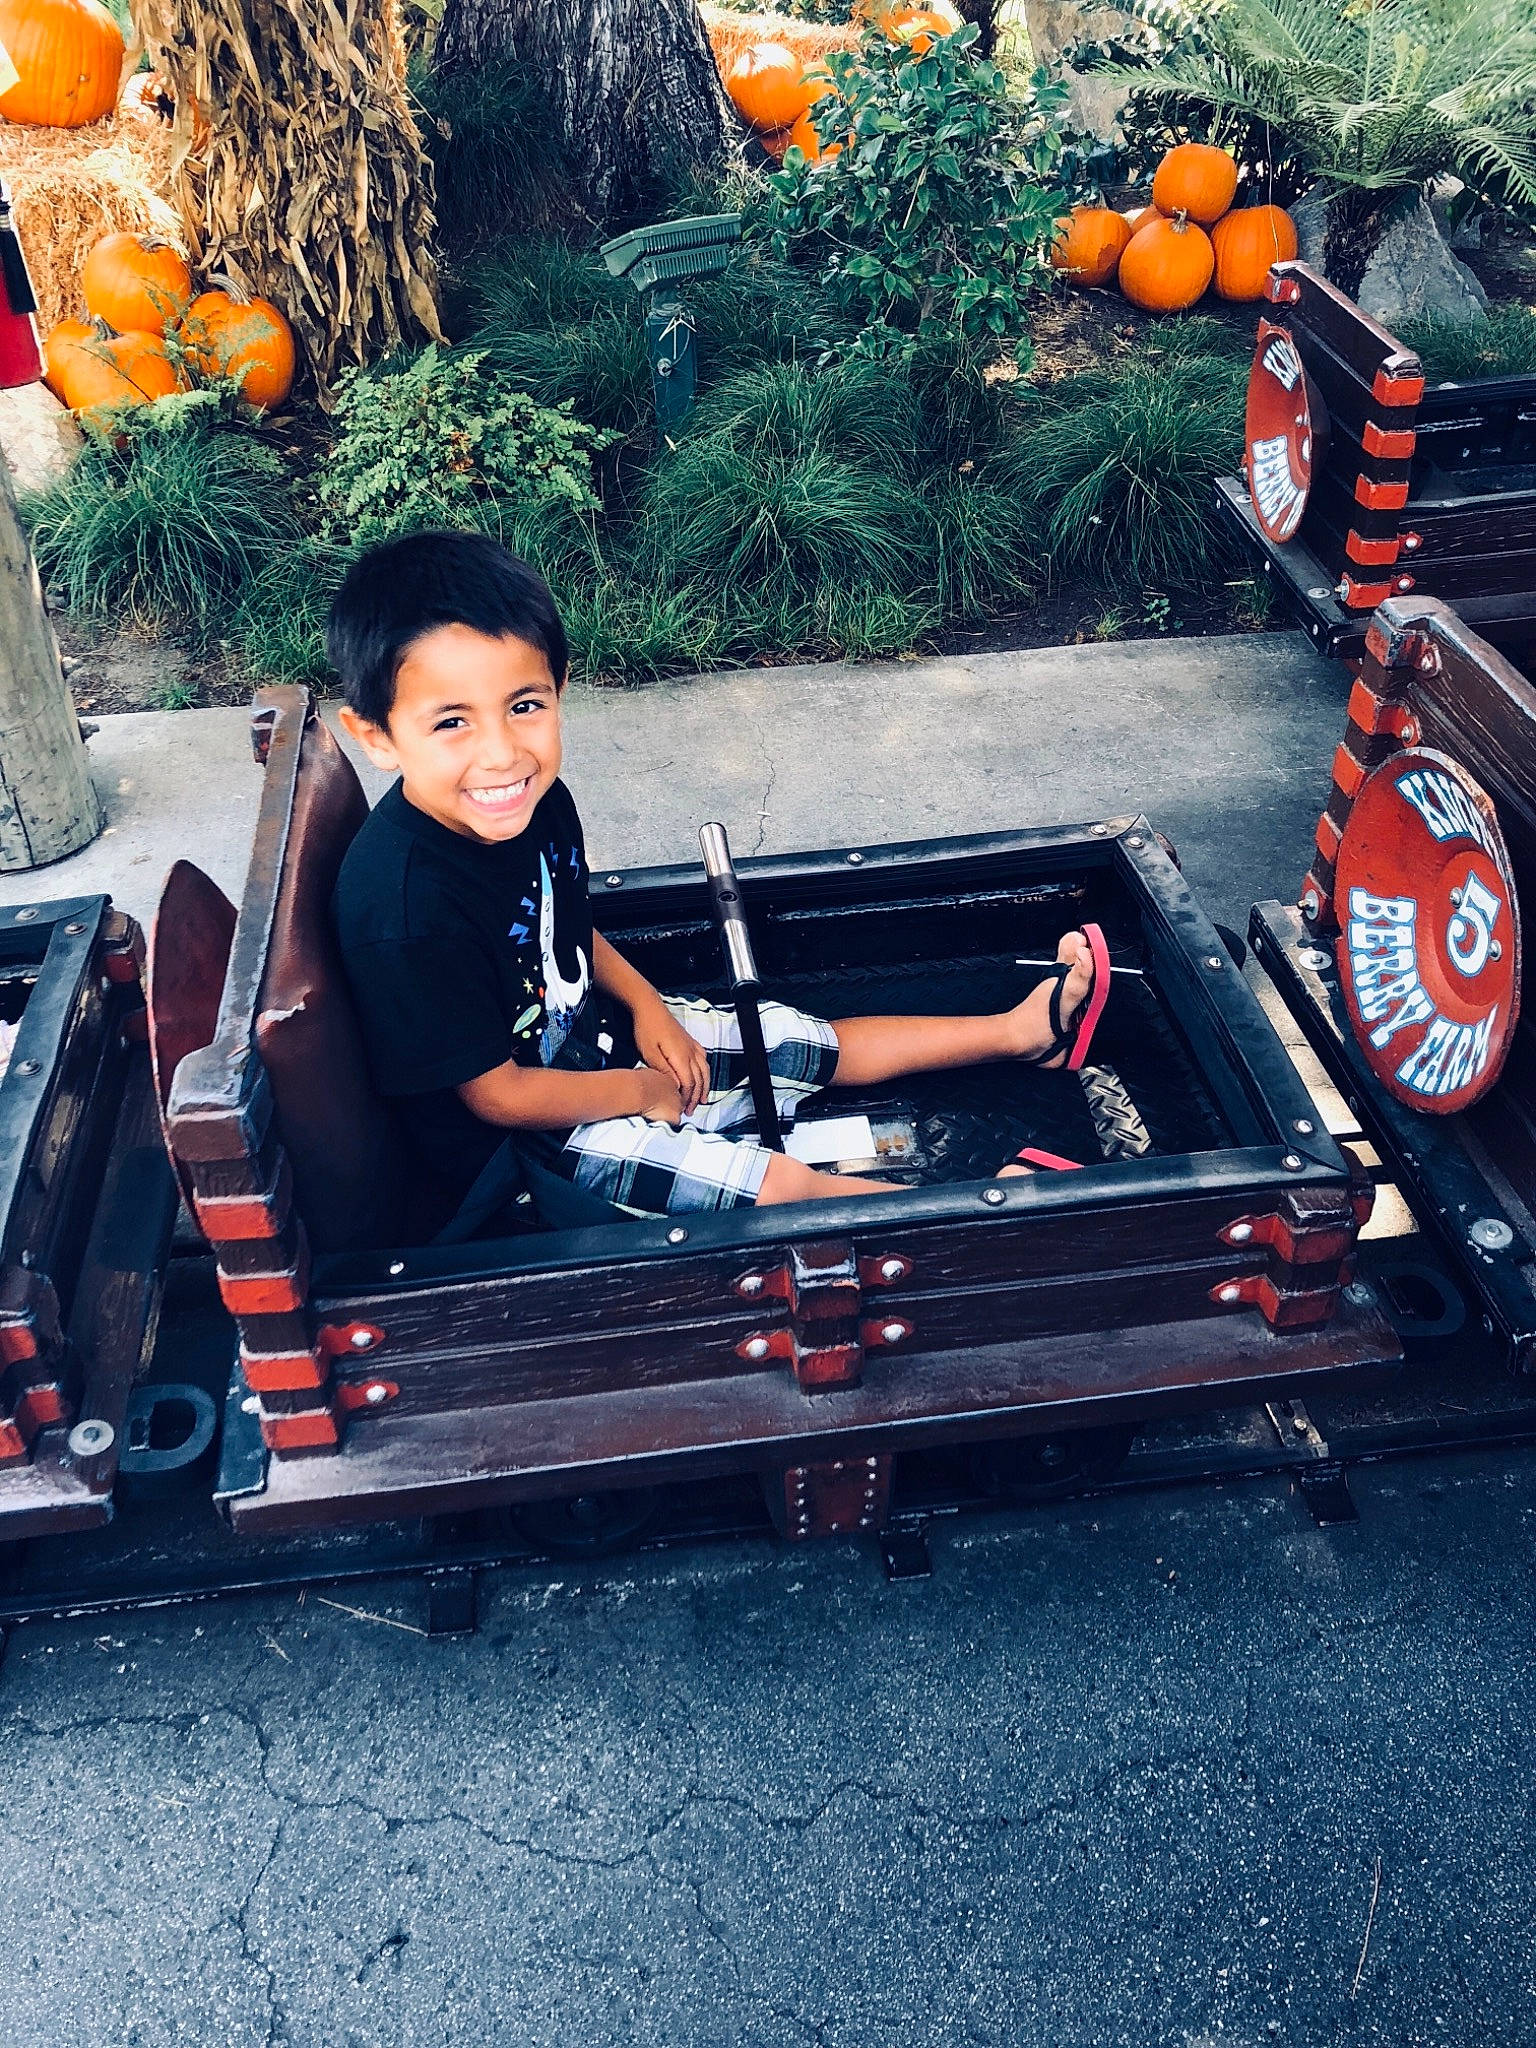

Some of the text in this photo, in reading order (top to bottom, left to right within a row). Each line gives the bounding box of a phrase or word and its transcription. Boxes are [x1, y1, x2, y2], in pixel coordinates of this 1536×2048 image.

[1253, 436, 1298, 528] BERRY
[1446, 869, 1502, 978] 5
[1348, 886, 1436, 1050] BERRY
[1394, 1003, 1498, 1096] FARM
